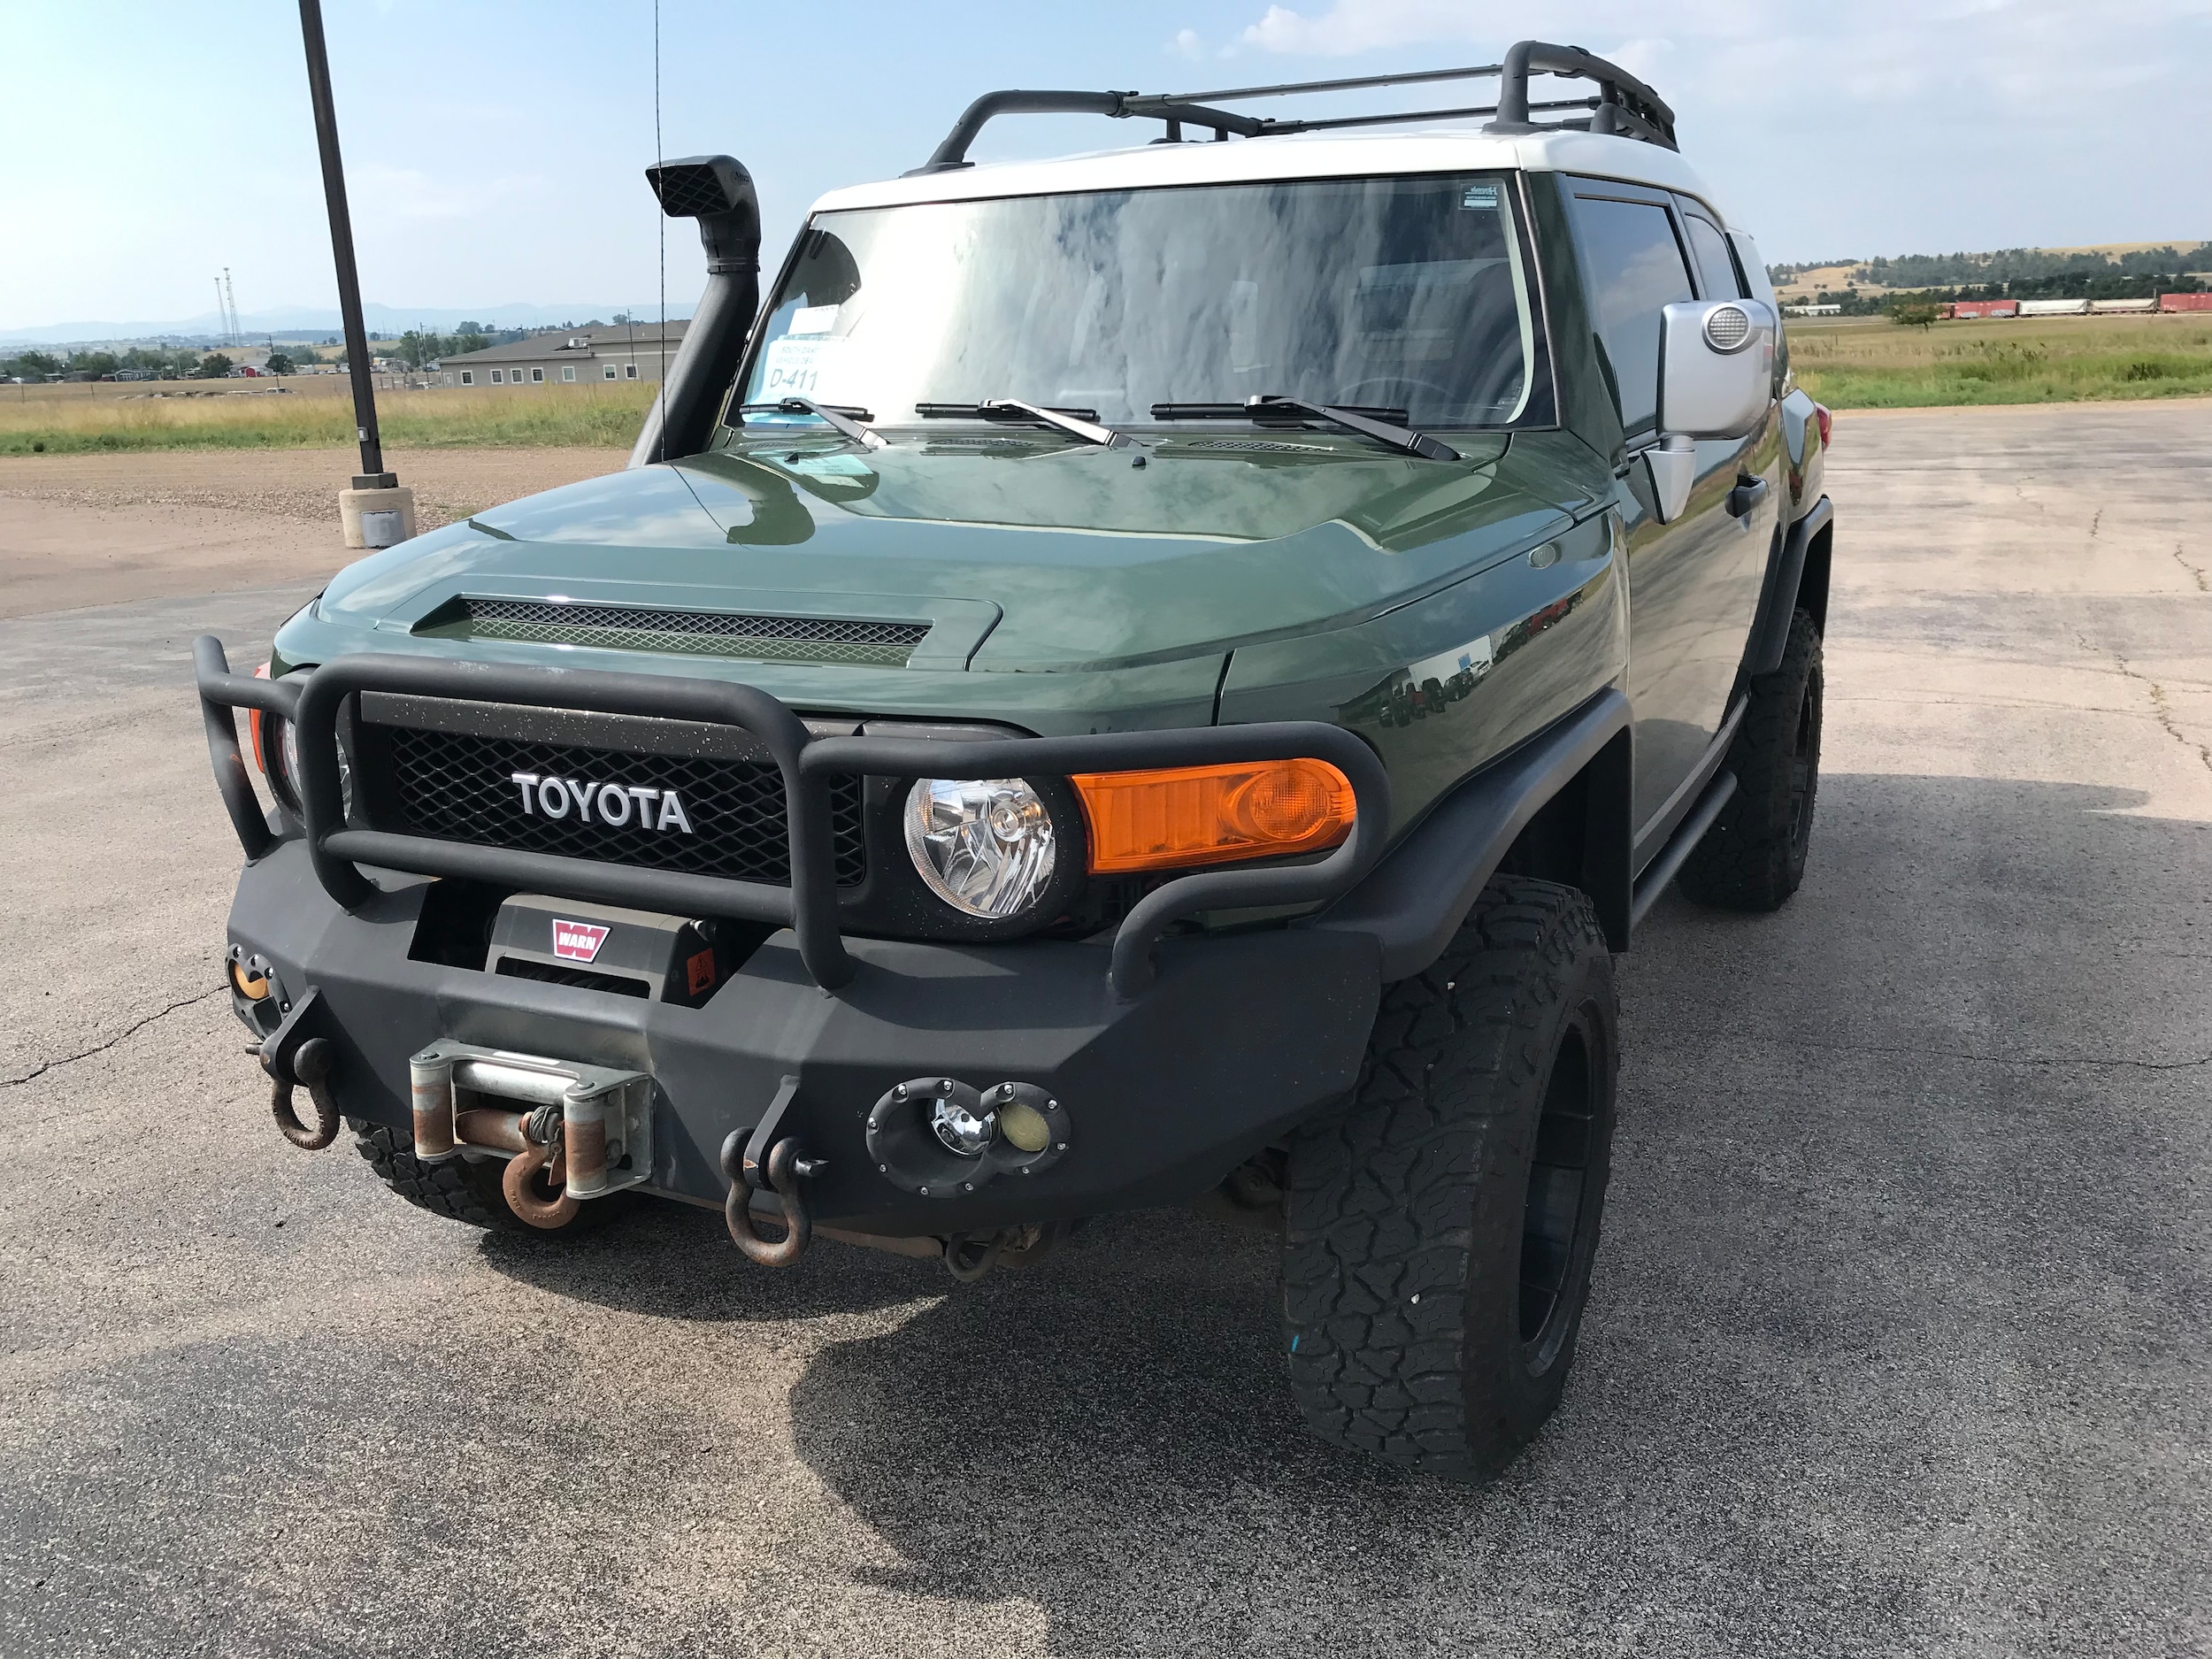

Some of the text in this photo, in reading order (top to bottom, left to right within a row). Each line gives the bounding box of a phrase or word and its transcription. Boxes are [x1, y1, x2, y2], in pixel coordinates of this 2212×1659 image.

[770, 368, 818, 391] D-411
[511, 772, 694, 834] TOYOTA
[558, 932, 596, 950] WARN
